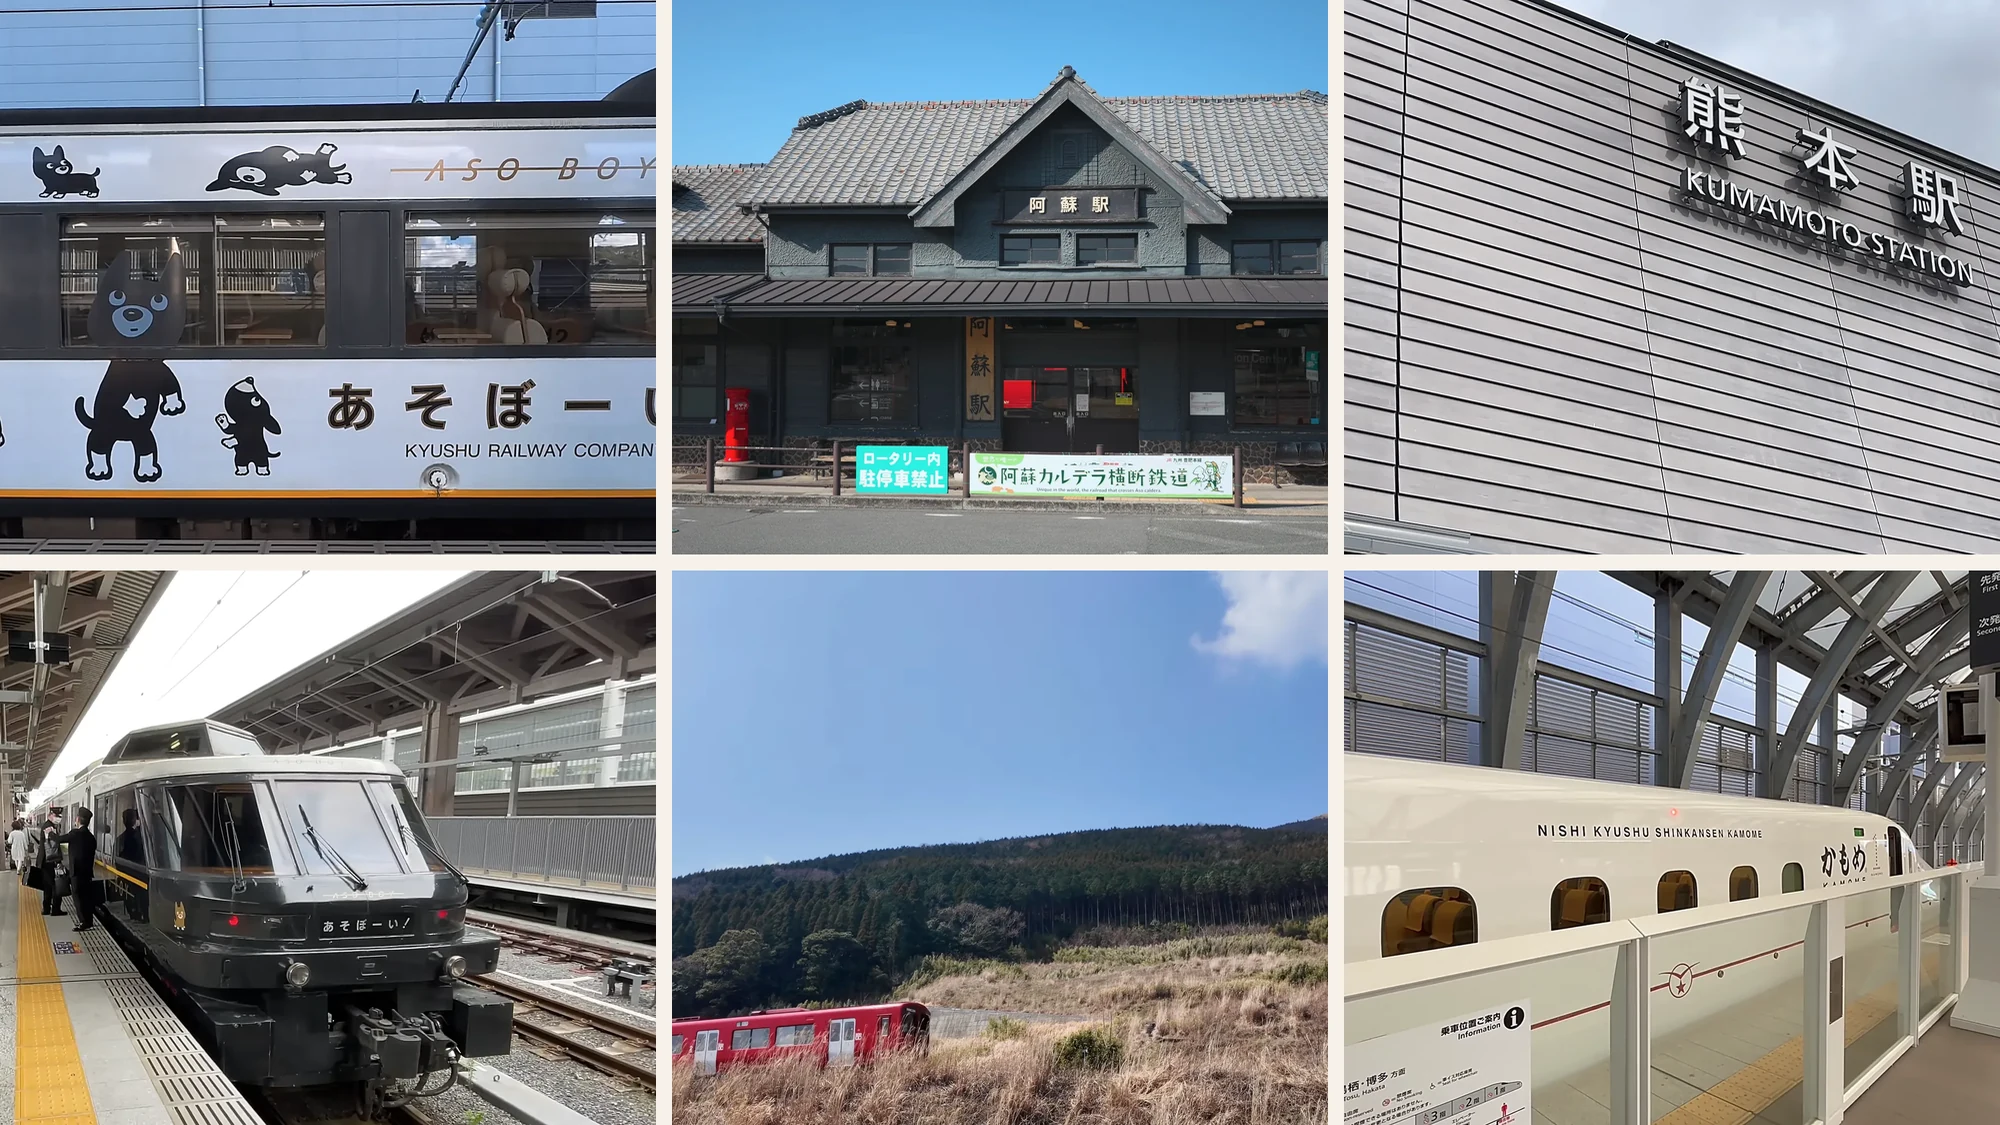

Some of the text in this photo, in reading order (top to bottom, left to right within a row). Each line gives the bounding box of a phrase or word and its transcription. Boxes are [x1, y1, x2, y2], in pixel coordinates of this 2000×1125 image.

[1679, 76, 1966, 237] 熊本駅
[424, 156, 656, 182] ASO BOY
[1028, 195, 1111, 215] 阿蘇駅
[1682, 167, 1974, 285] KUMAMOTO STATION
[969, 316, 992, 416] 阿蘇駅
[405, 443, 656, 458] KYUSHU RAILWAY COMPAN
[863, 451, 941, 467] ロータリー内
[858, 469, 945, 489] 駐停車禁止
[1000, 467, 1188, 487] 阿蘇カルデラ横断鉄道
[1982, 584, 1998, 593] First
[1537, 824, 1763, 839] NISHI KYUSHU SHINKANSEN KAMOME
[1820, 843, 1866, 878] かもめ
[1440, 1012, 1501, 1037] 乗車位置ご案内
[1458, 1022, 1501, 1040] Information
[1361, 1084, 1386, 1096] Hakata
